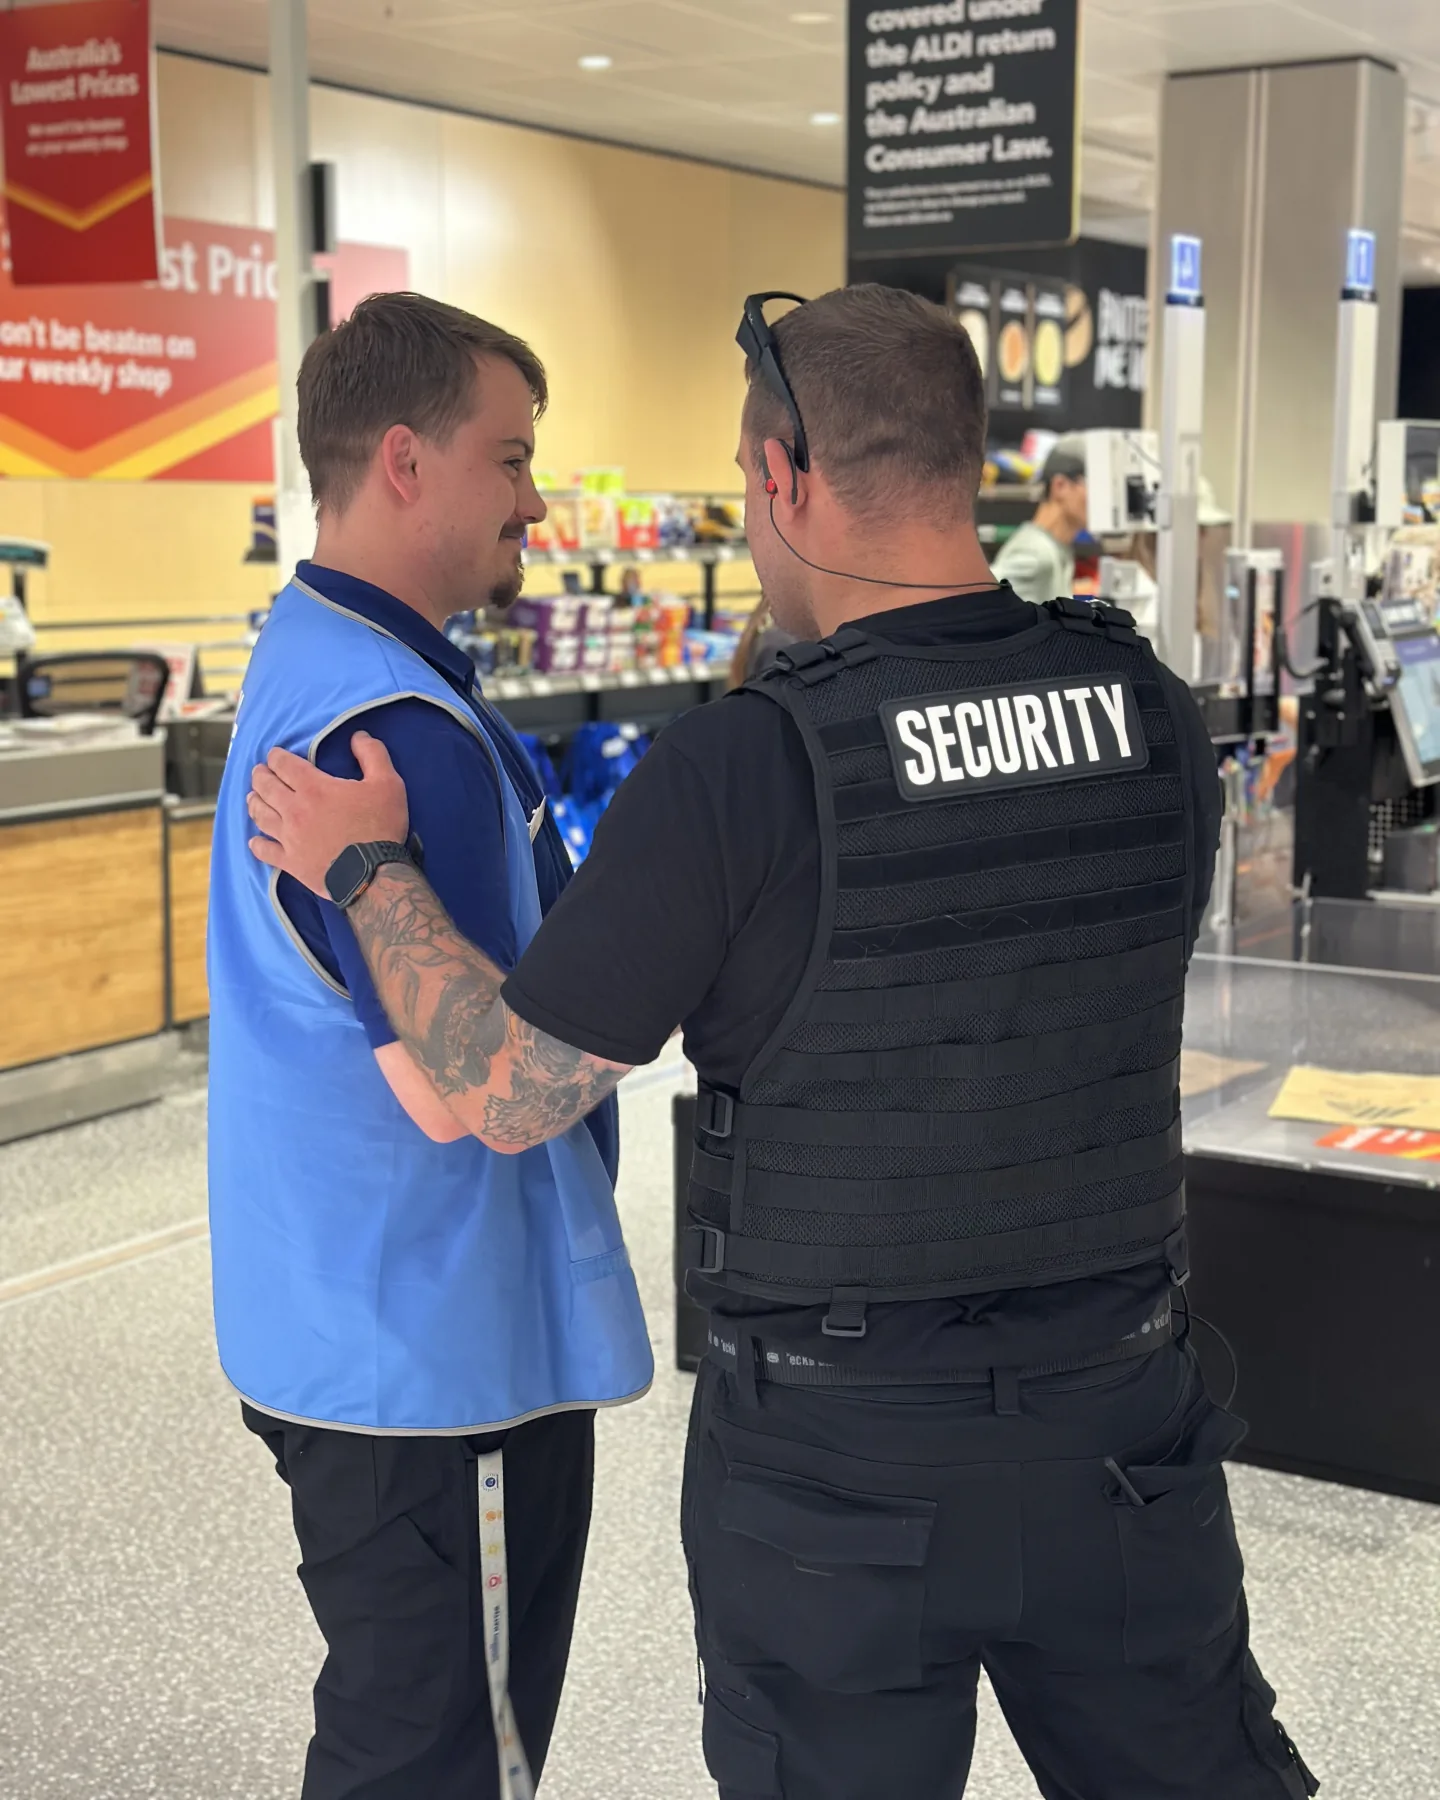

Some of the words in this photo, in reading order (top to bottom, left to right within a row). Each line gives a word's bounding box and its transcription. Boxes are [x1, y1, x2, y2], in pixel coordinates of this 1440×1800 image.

[866, 0, 965, 33] covered
[968, 0, 1043, 22] under
[26, 38, 122, 73] Australia's
[865, 38, 908, 68] the
[911, 31, 973, 63] ALDI
[976, 27, 1057, 56] return
[10, 75, 76, 106] Lowest
[79, 71, 139, 98] Prices
[865, 71, 943, 110] policy
[944, 62, 995, 96] and
[864, 109, 907, 138] the
[909, 98, 1037, 134] Australian
[865, 143, 990, 173] Consumer
[992, 134, 1053, 163] Law.
[143, 240, 199, 294] st
[207, 241, 279, 299] Pric
[0, 316, 47, 349] on't
[50, 319, 81, 351] be
[85, 321, 163, 357] beaten
[167, 334, 196, 360] on
[0, 357, 25, 382] ur
[29, 355, 112, 394] weekly
[116, 359, 172, 397] shop
[895, 684, 1132, 786] SECURITY
